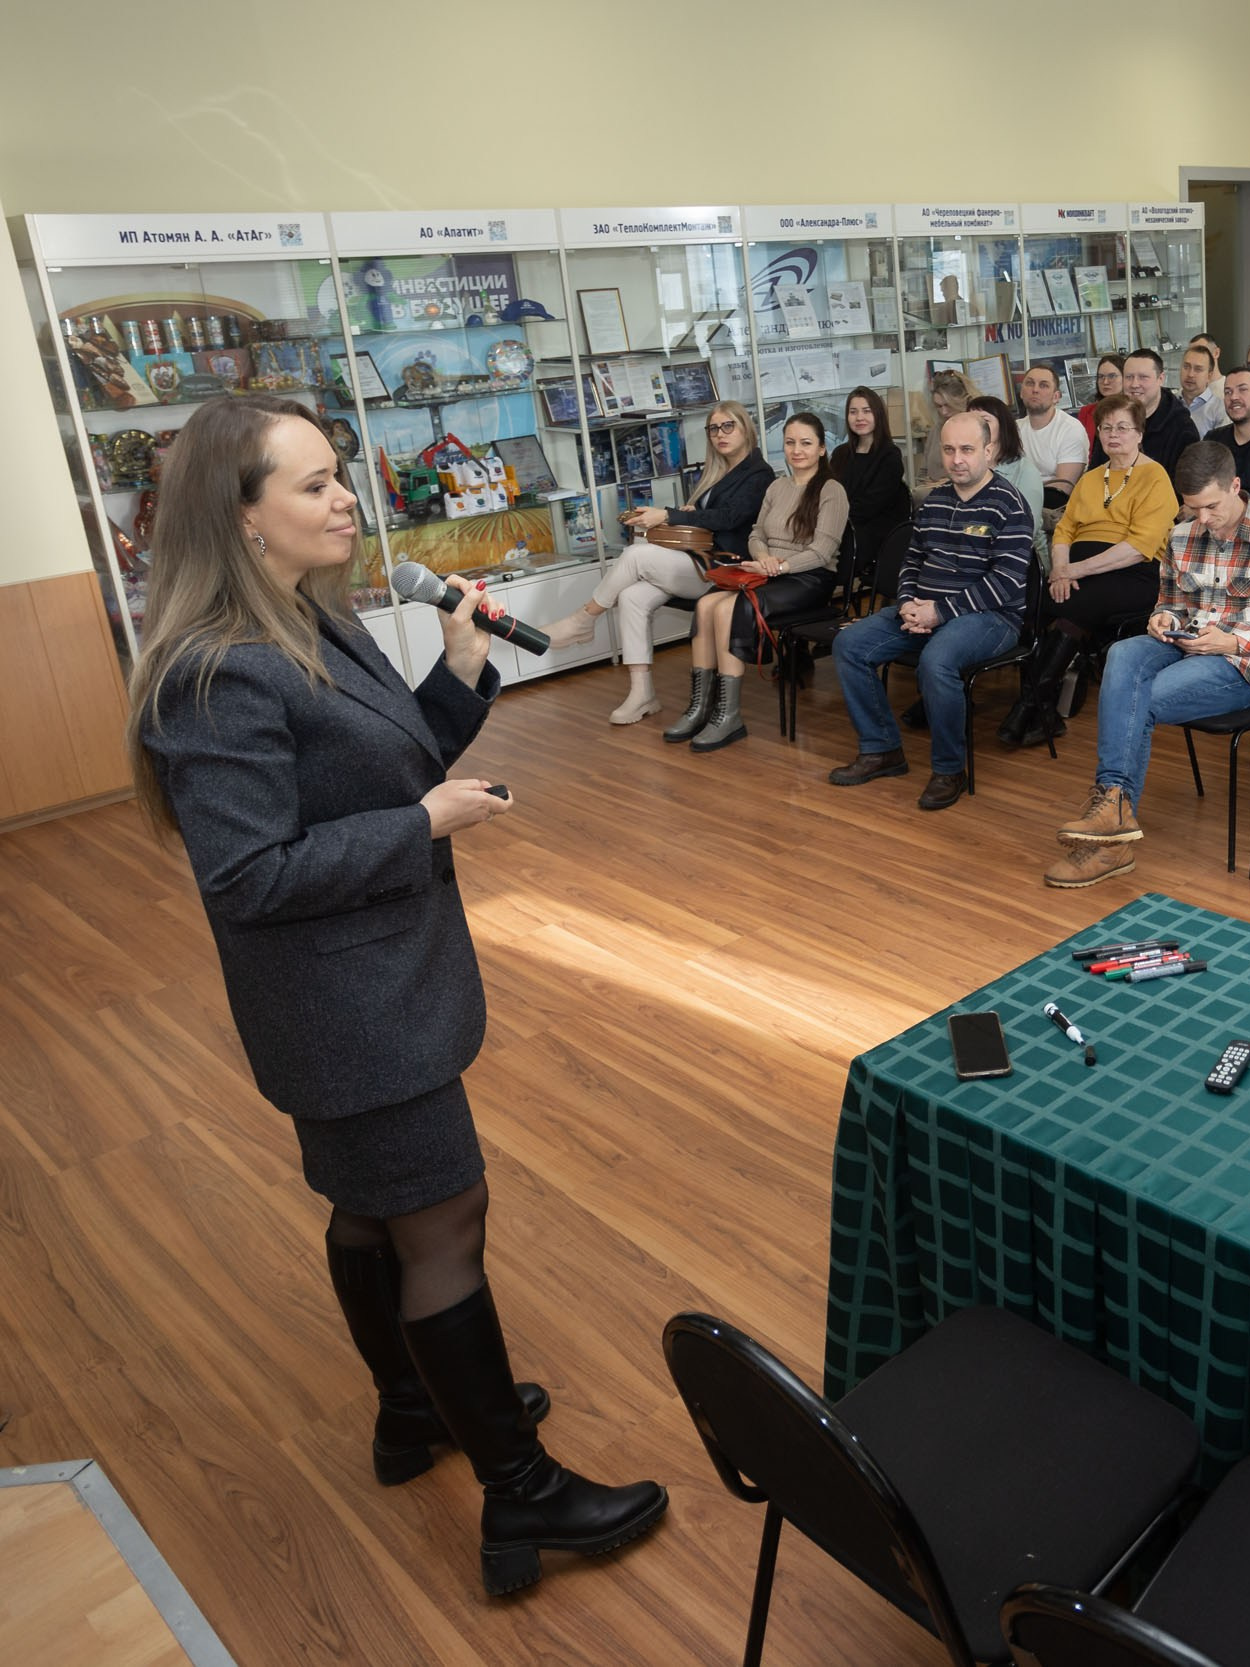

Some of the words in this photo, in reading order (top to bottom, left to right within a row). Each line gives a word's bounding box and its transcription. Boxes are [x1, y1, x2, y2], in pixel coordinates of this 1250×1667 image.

[922, 208, 930, 216] АО
[780, 218, 794, 228] ООО
[796, 217, 863, 228] «Александра-Плюс»
[420, 227, 433, 238] АО
[437, 226, 484, 238] «Апатит»
[593, 223, 609, 234] ЗАО
[119, 231, 138, 243] ИП
[143, 230, 190, 243] Атомян
[195, 230, 207, 242] А.
[211, 230, 223, 242] А.
[227, 229, 272, 241] «АтАг»
[1007, 316, 1081, 339] NODINKRAFT
